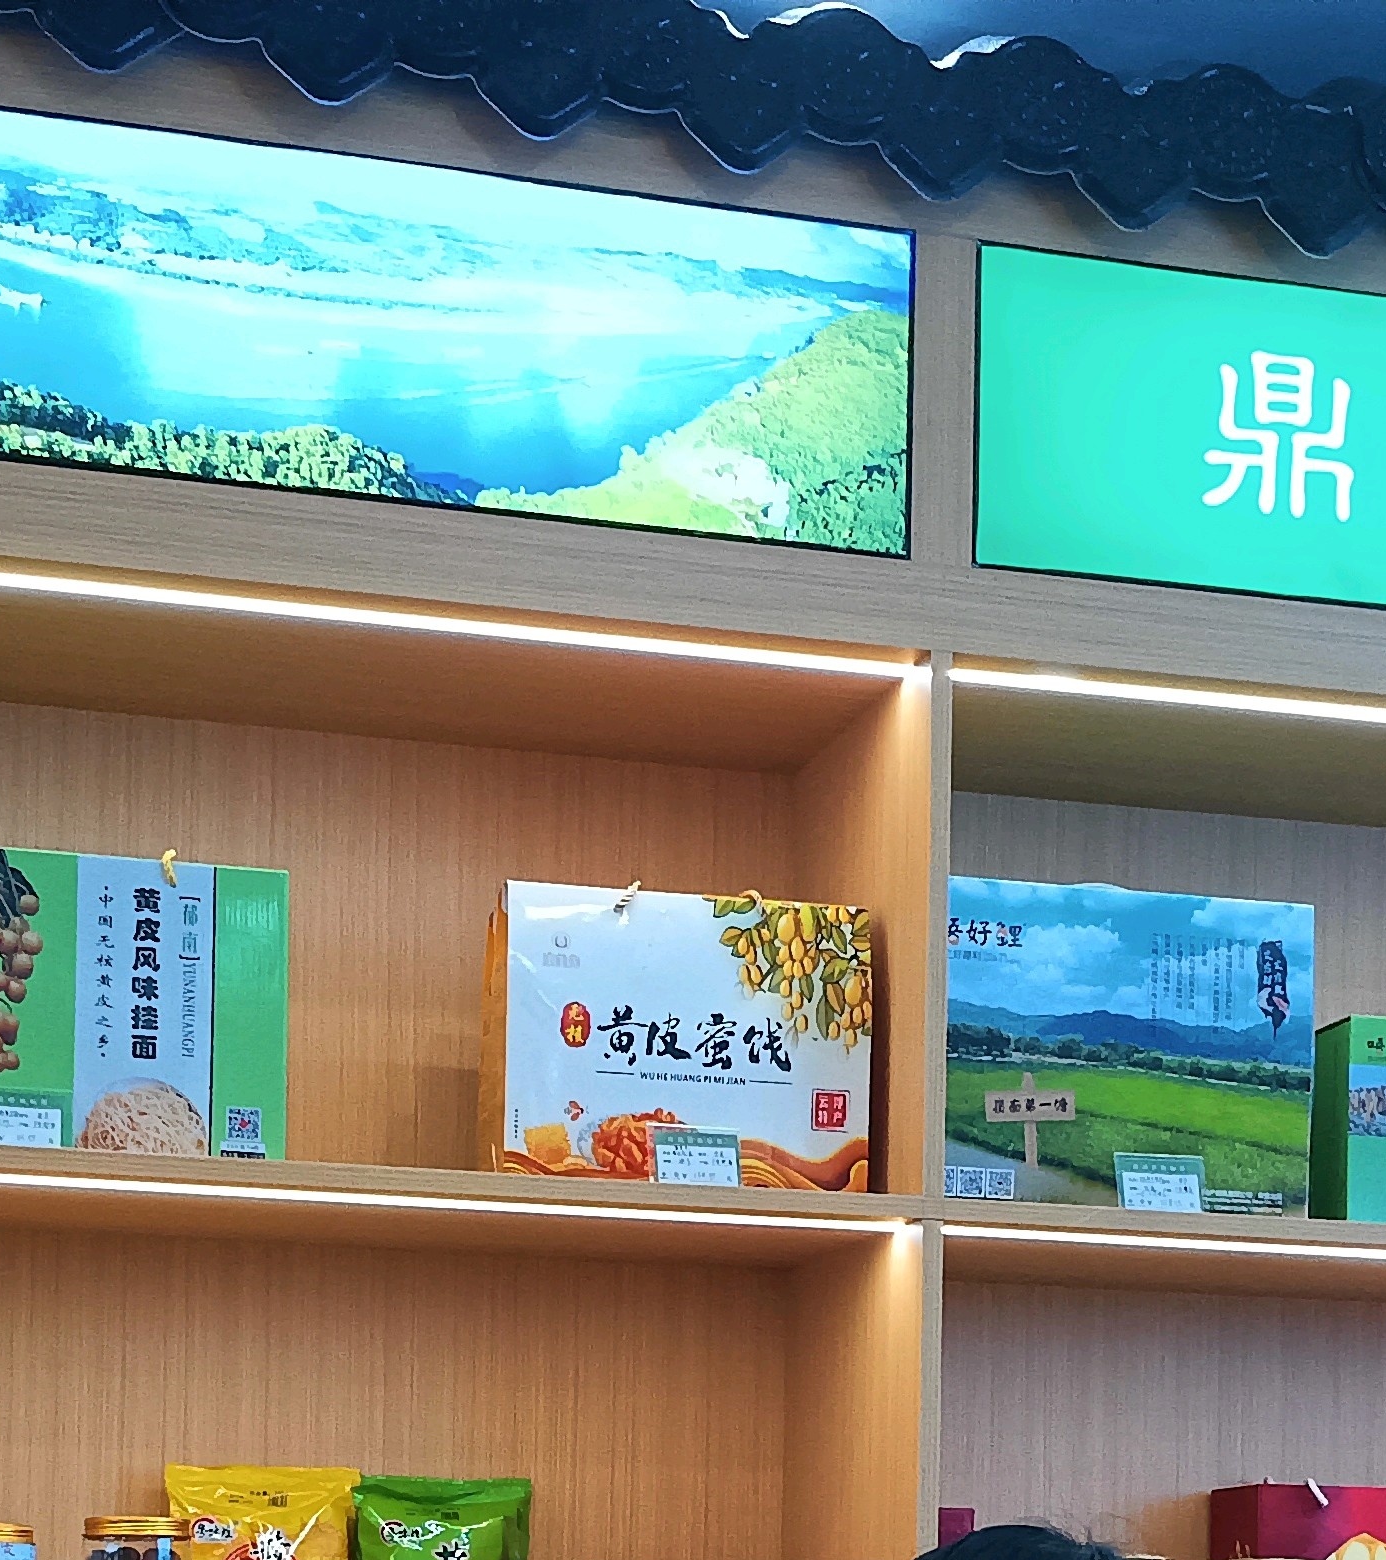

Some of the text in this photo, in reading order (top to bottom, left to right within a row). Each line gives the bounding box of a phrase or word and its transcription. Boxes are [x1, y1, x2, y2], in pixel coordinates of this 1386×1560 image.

[131, 888, 161, 1060] 黄皮风味挂面
[597, 1005, 793, 1071] 黄皮蜜饯
